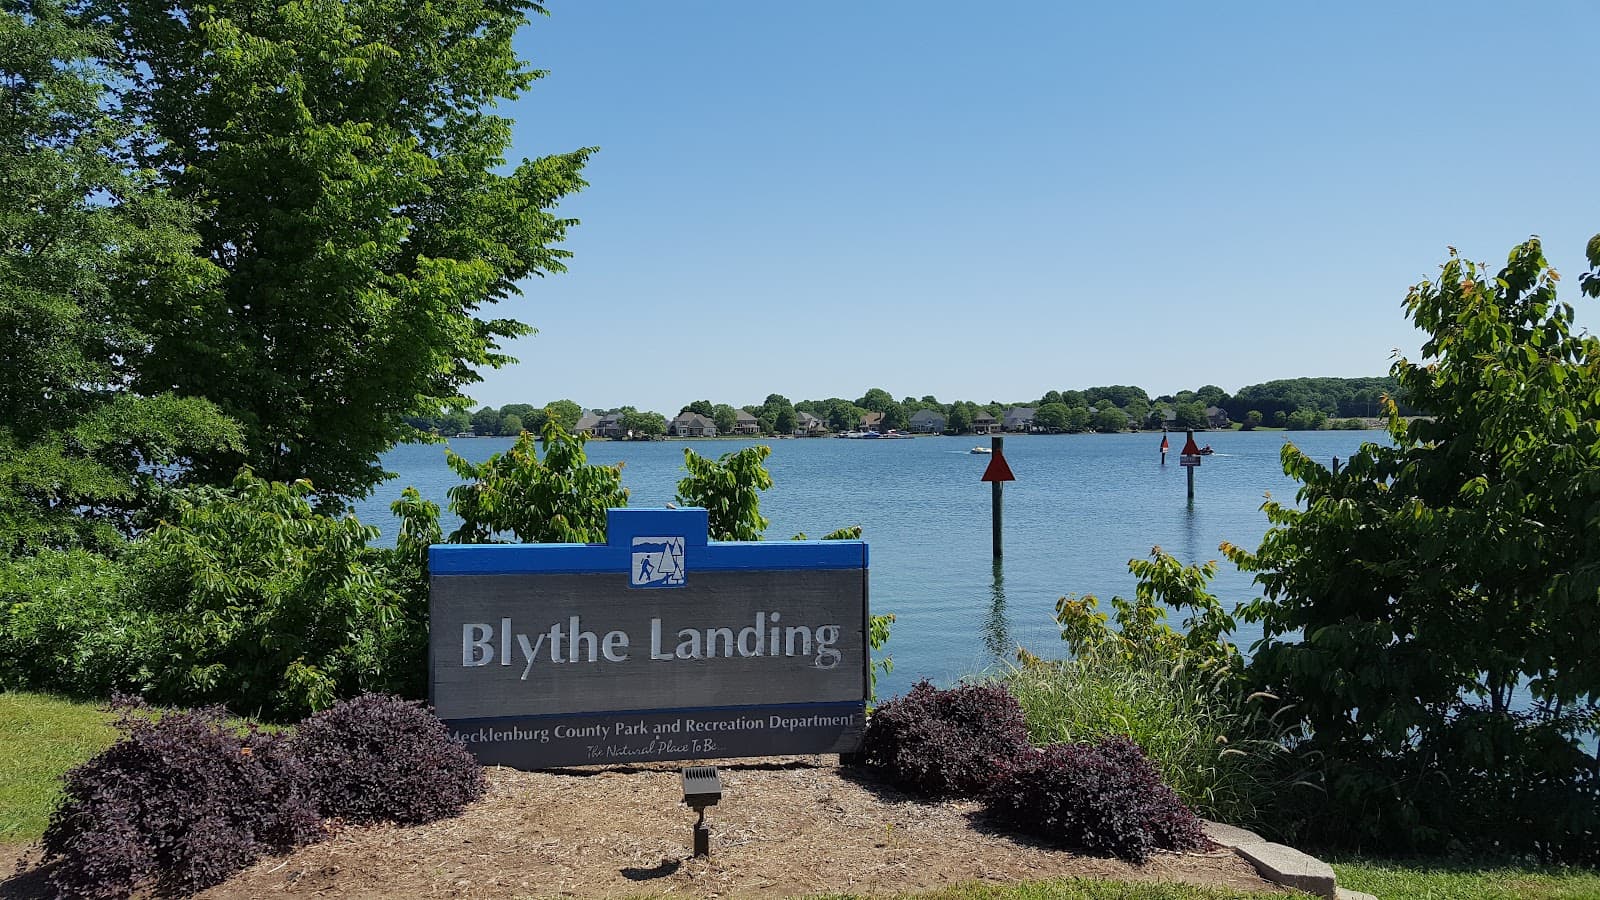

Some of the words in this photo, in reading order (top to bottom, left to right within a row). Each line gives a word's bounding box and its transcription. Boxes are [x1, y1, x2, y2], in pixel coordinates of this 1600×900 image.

[462, 615, 630, 680] Blythe
[651, 611, 841, 670] Landing
[554, 723, 611, 741] County
[615, 720, 648, 736] Park
[653, 719, 681, 734] and
[686, 716, 764, 732] Recreation
[769, 713, 855, 732] Department
[587, 744, 603, 758] The
[606, 741, 656, 758] Natural
[657, 740, 689, 755] Place
[692, 740, 702, 753] To
